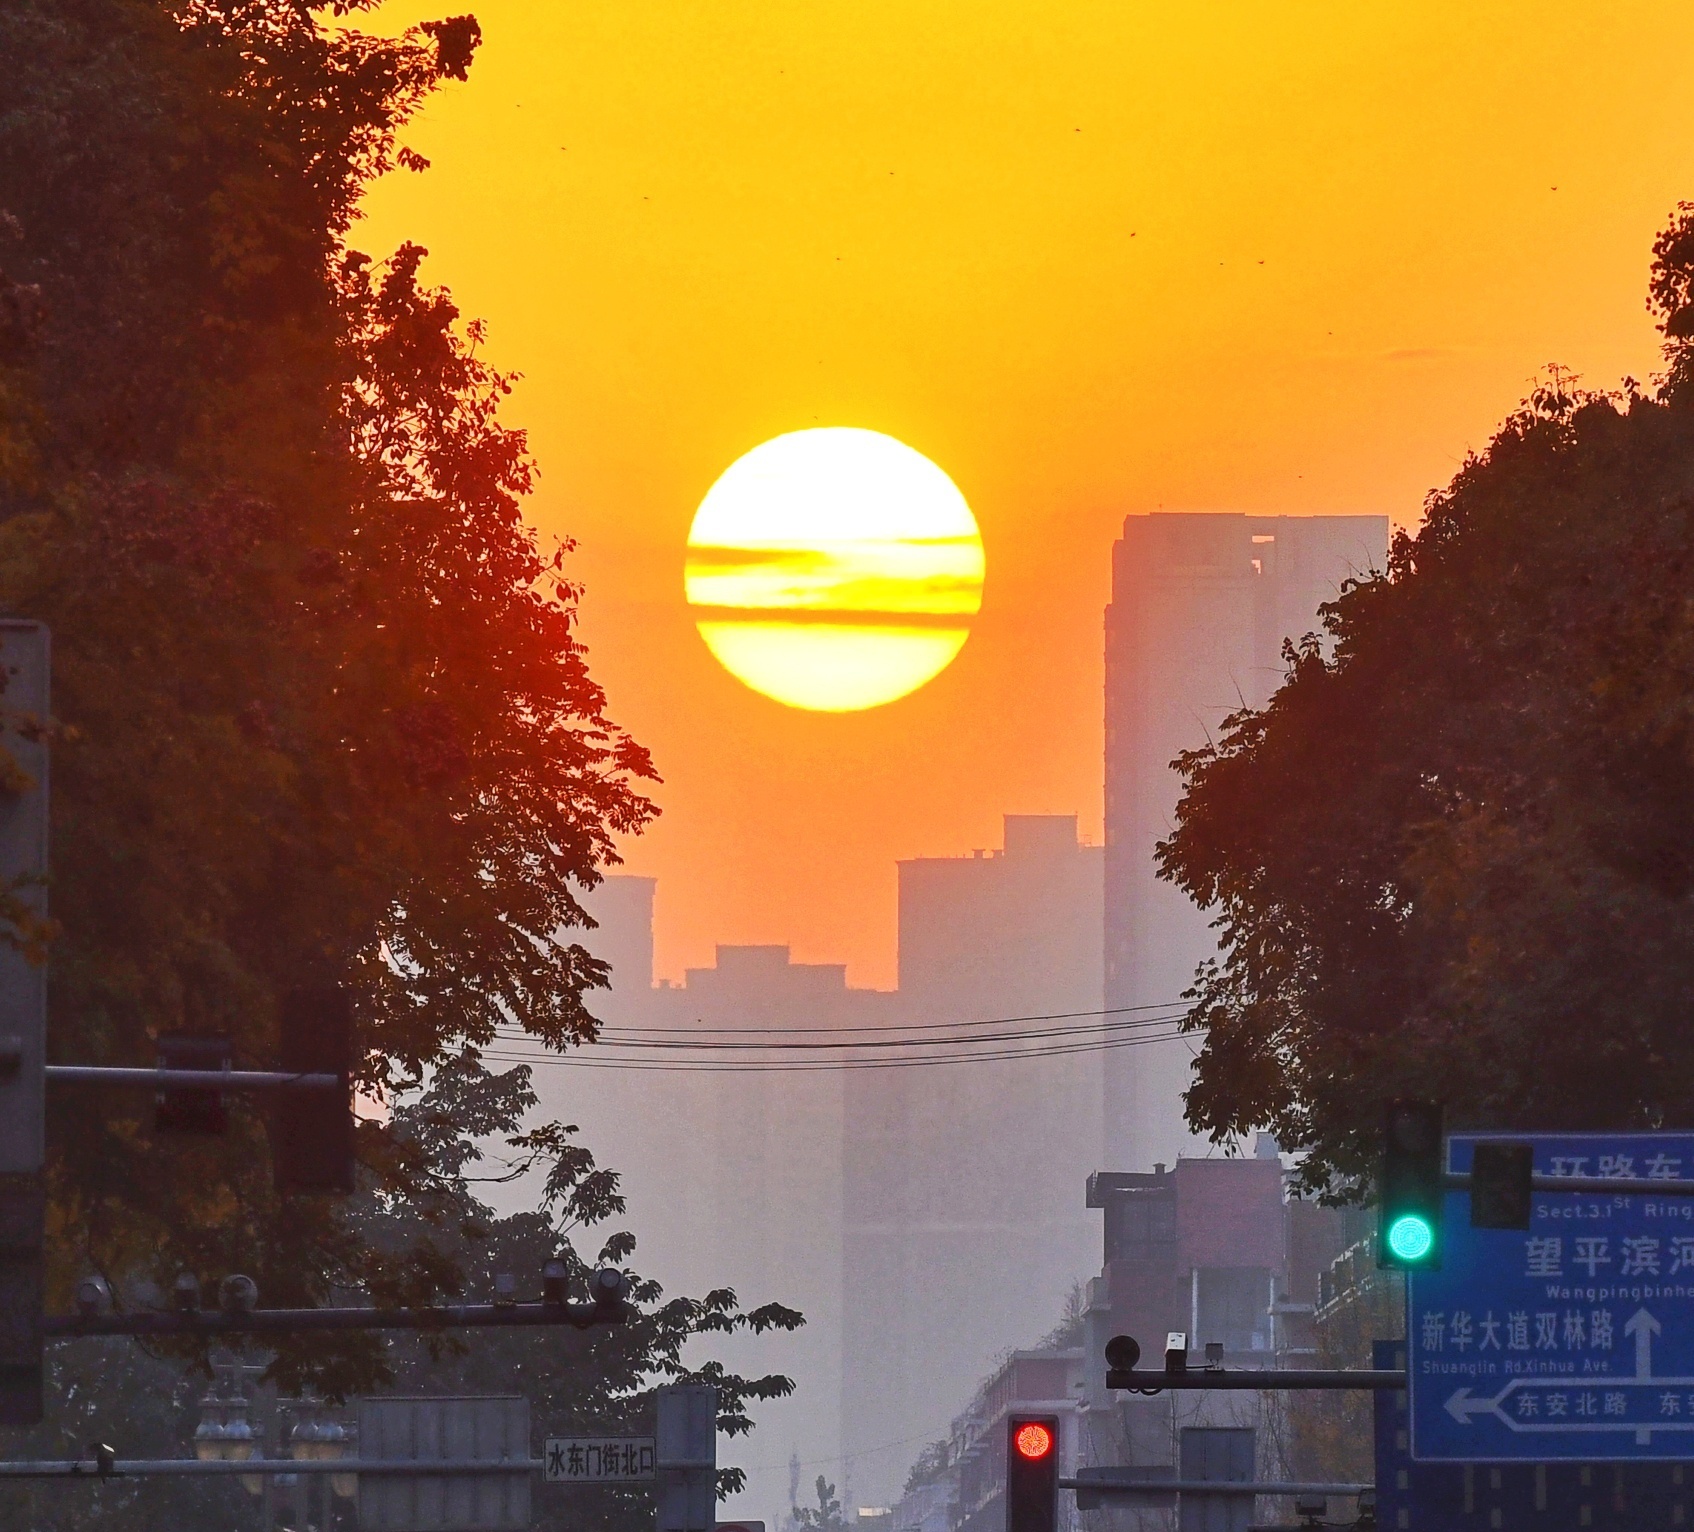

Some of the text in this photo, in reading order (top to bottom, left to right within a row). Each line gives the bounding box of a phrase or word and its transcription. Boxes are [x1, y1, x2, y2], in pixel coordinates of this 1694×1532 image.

[1644, 1203, 1692, 1220] Ring
[1524, 1235, 1694, 1277] 望平滨河
[1421, 1308, 1614, 1352] 新华大道双林路
[1422, 1360, 1497, 1378] Shuanglin
[1516, 1391, 1628, 1417] 东安北路
[548, 1442, 655, 1477] 水东门街北口
